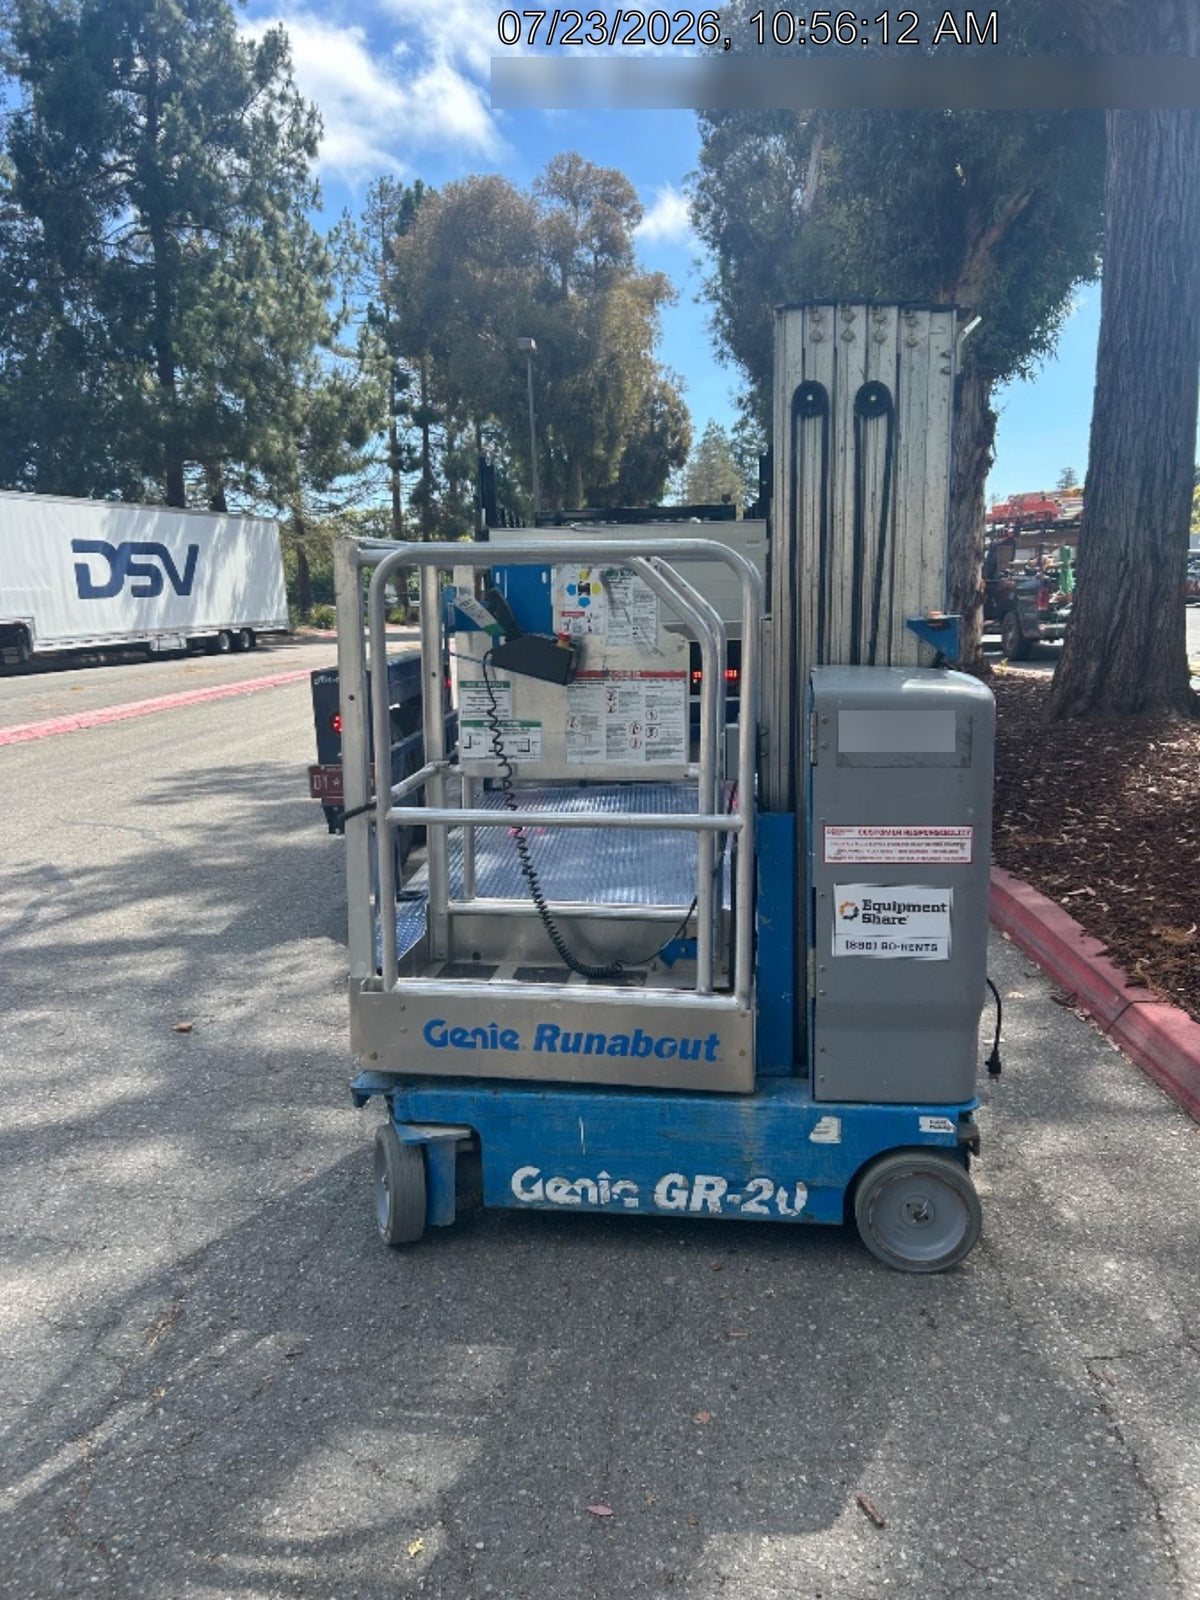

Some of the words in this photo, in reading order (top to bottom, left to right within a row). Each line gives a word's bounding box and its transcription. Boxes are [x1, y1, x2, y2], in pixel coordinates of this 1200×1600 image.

[71, 538, 200, 600] DSV
[861, 899, 948, 914] Equipment
[861, 913, 907, 925] Share
[422, 1019, 520, 1051] Genie
[532, 1023, 721, 1062] Runabout
